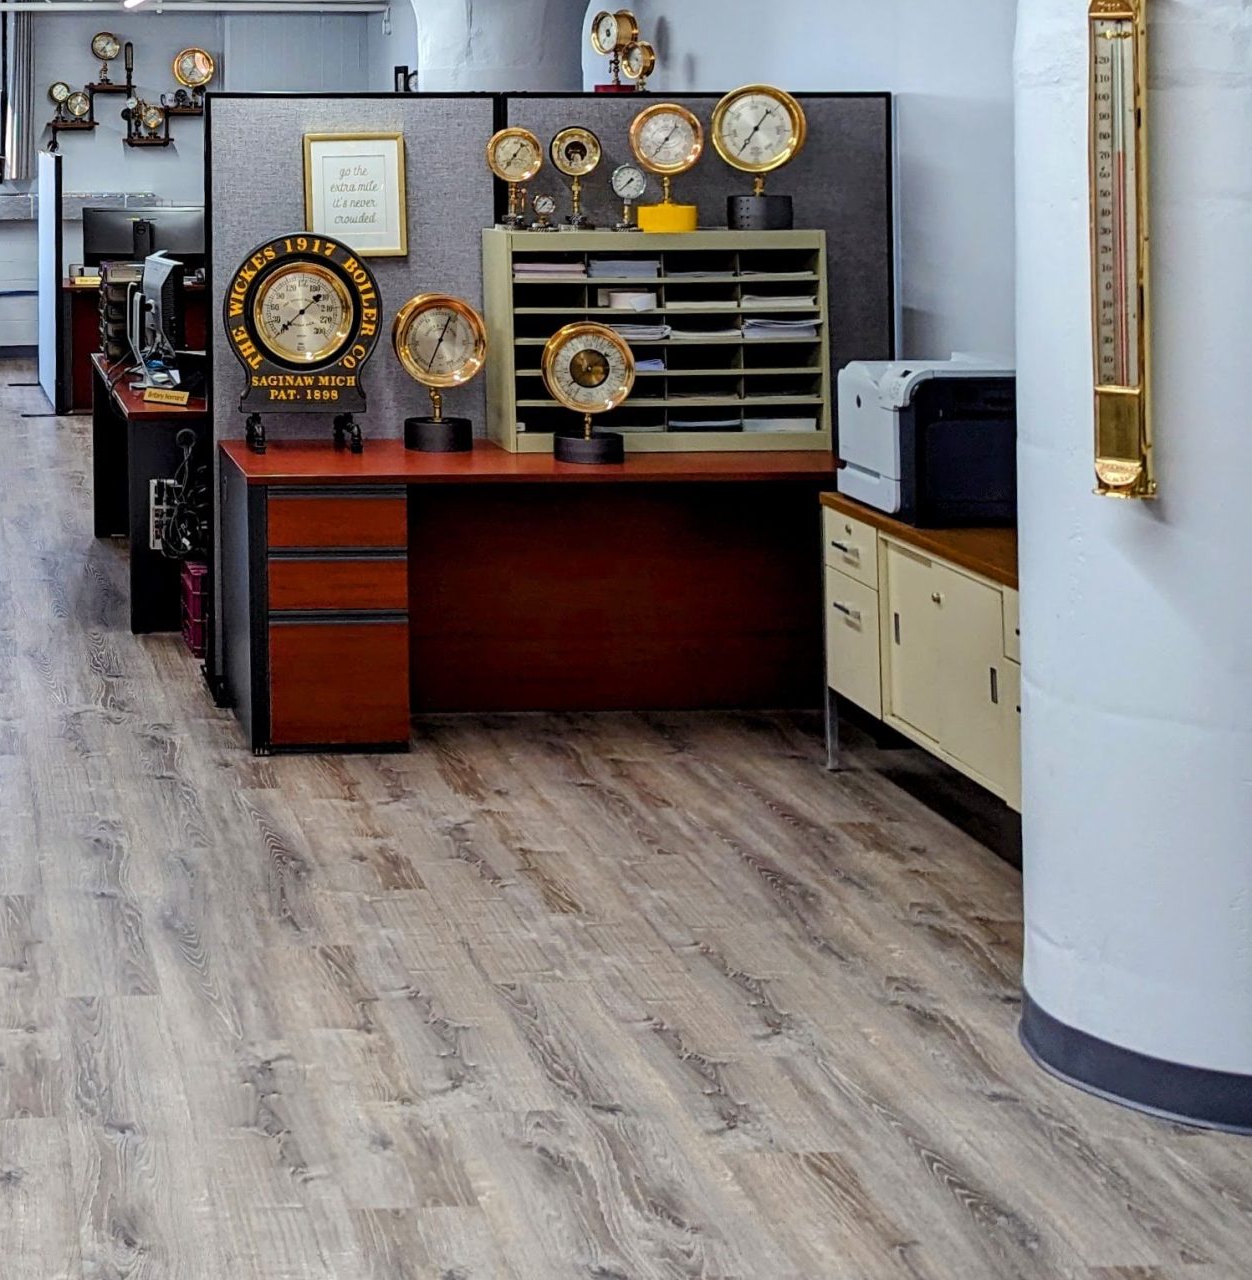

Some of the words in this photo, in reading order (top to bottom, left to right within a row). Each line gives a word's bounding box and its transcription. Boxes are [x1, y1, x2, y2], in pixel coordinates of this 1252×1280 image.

[339, 167, 351, 180] go
[353, 165, 368, 177] the
[330, 181, 357, 193] extra
[358, 180, 379, 192] mile
[333, 197, 348, 209] it's
[350, 200, 378, 209] never
[334, 212, 377, 224] crowded
[284, 237, 336, 256] 1917
[229, 246, 276, 318] WICKES
[1106, 282, 1112, 290] 0
[341, 257, 377, 336] BOILER
[231, 325, 264, 370] THE
[338, 344, 366, 370] CO.
[252, 375, 314, 387] SAGINAW
[318, 375, 356, 387] MICH
[270, 389, 300, 401] PAT.
[306, 389, 338, 400] 1898
